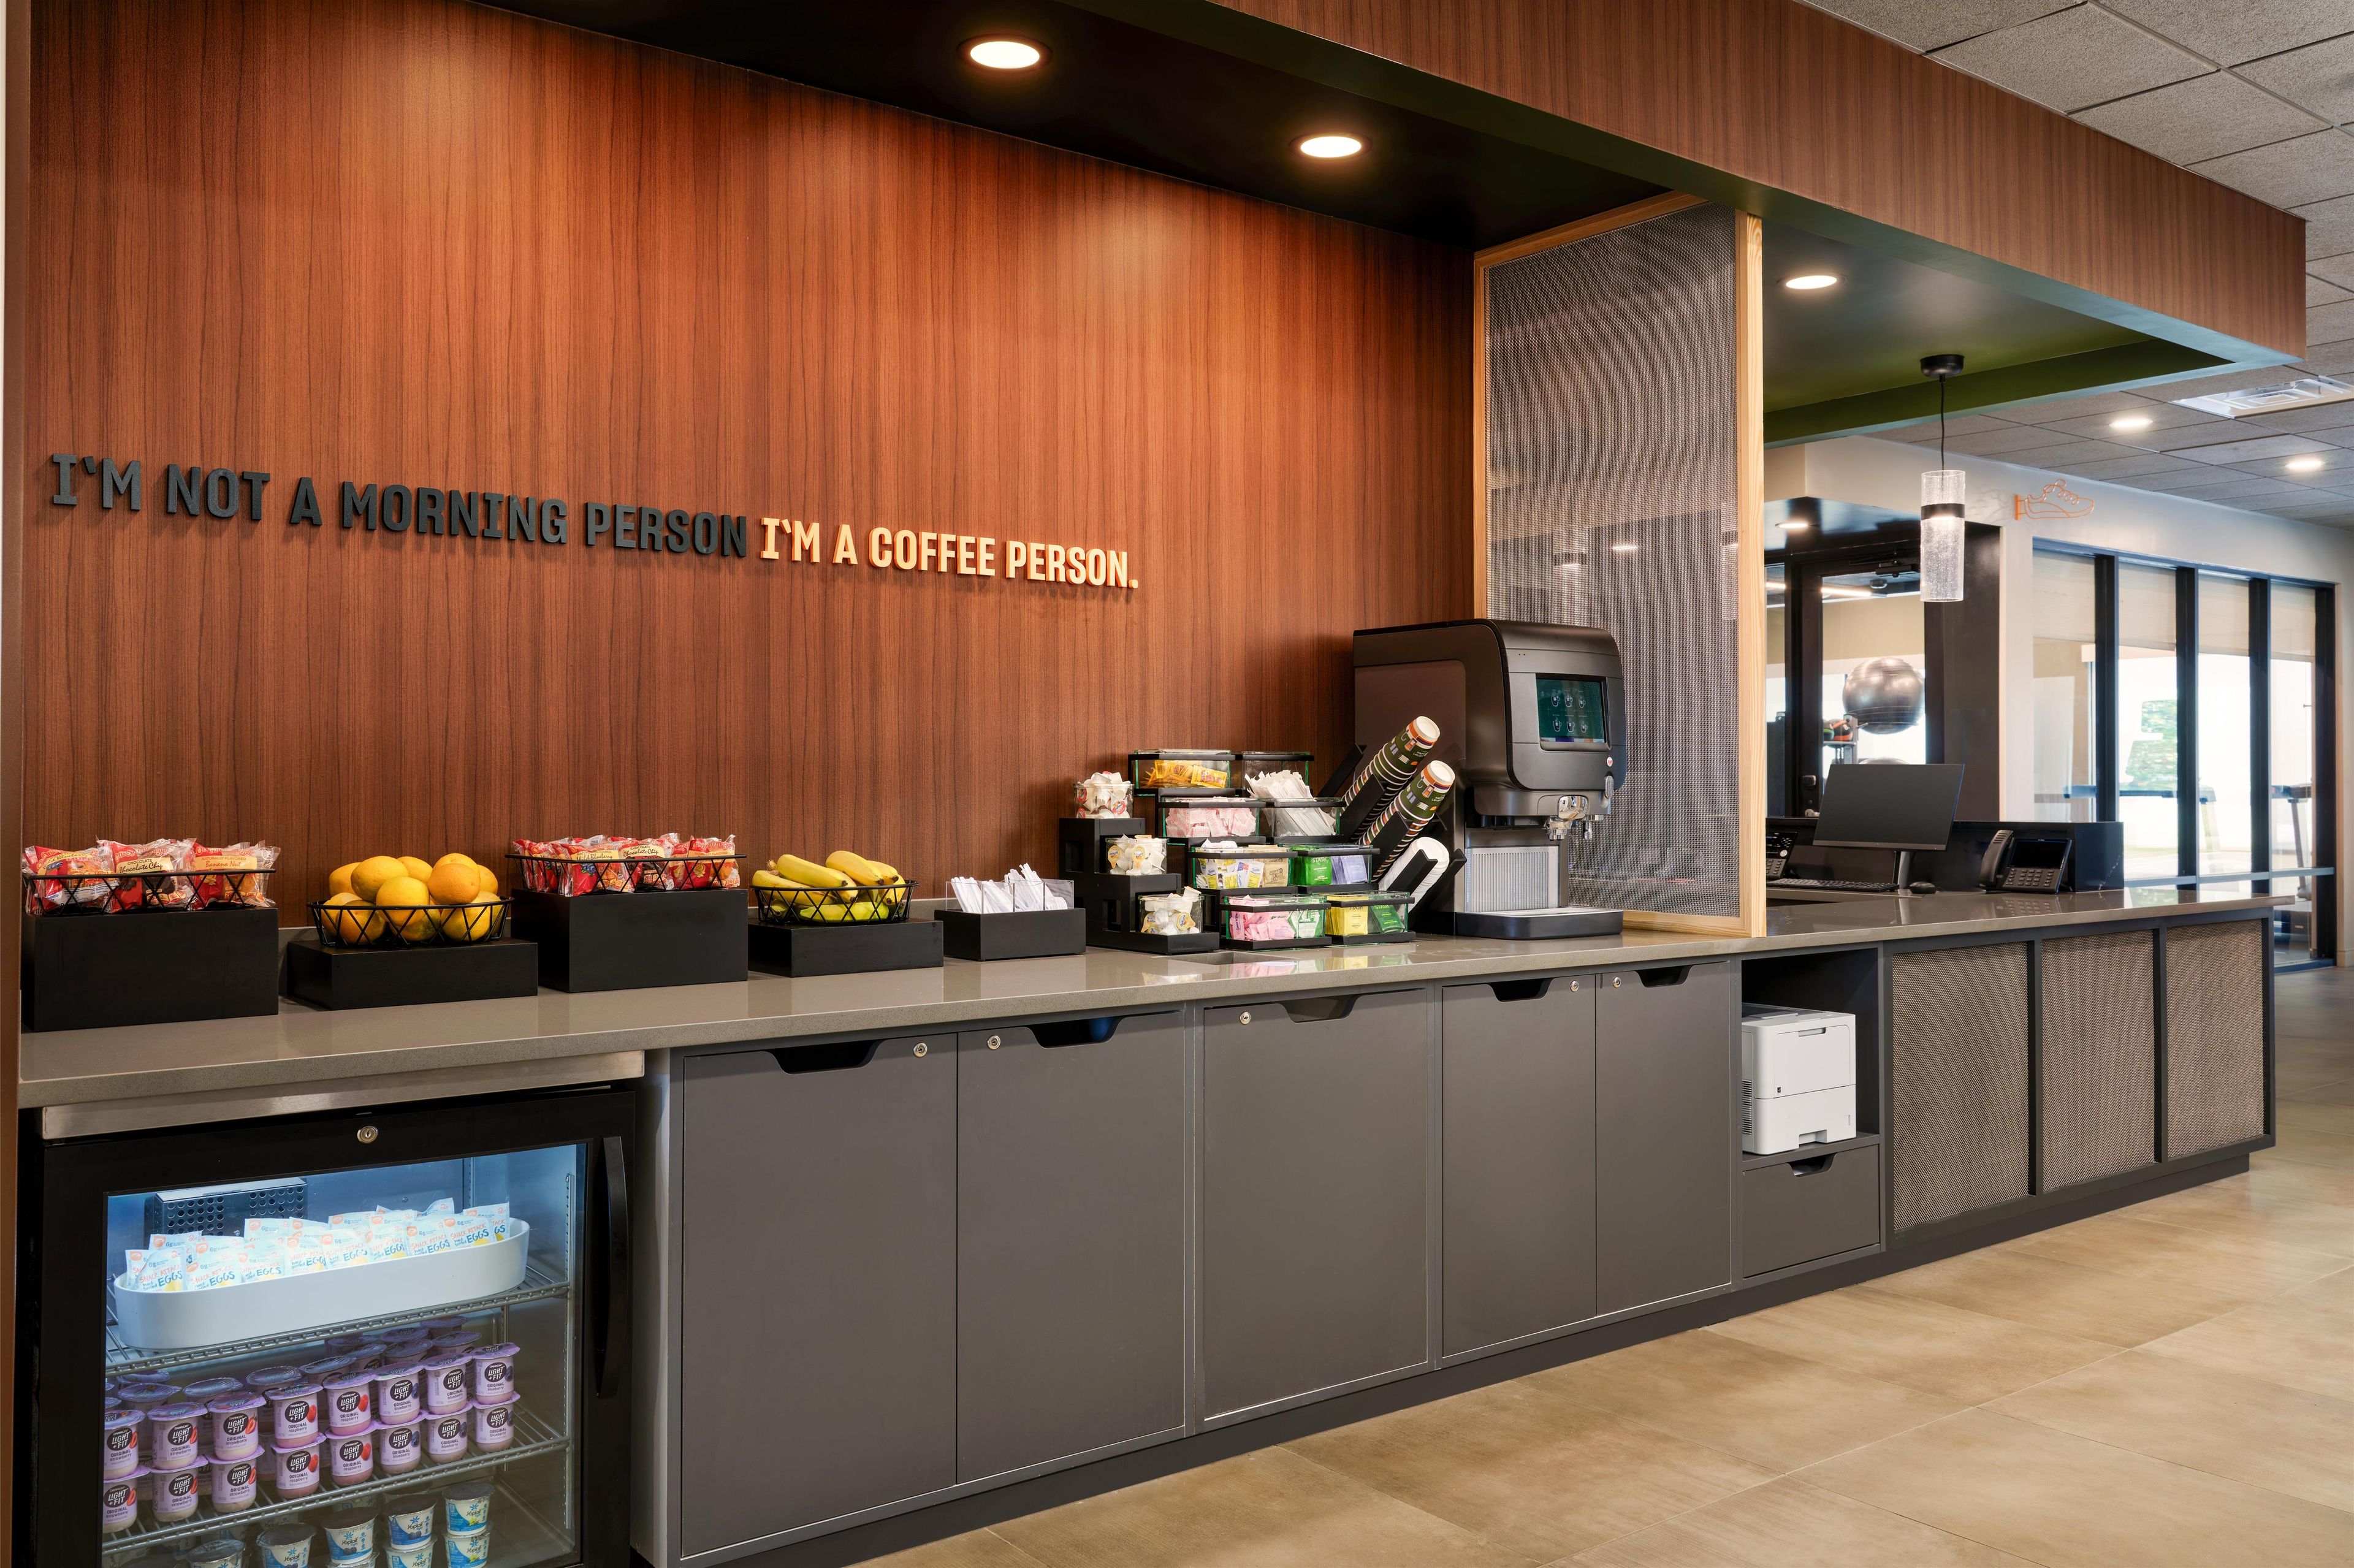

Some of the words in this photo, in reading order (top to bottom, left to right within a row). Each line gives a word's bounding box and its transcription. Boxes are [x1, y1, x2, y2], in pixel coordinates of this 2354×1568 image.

[51, 453, 142, 511] I'M
[167, 463, 270, 520] NOT
[289, 477, 322, 526] A
[342, 481, 569, 544] MORNING
[585, 501, 747, 558] PERSON
[760, 517, 820, 563] I'M
[832, 523, 858, 565] A
[869, 527, 996, 577] COFFEE
[1005, 540, 1138, 589] PERSON.
[623, 848, 648, 857] Chocolate
[467, 1228, 489, 1243] EGGS
[494, 1225, 506, 1234] GS
[384, 1243, 405, 1256] EGGS
[427, 1239, 451, 1253] EGGS
[158, 1271, 183, 1287] EGGS
[210, 1271, 235, 1287] EGGS
[488, 1366, 505, 1376] LIGHT
[447, 1372, 462, 1384] LIGHT
[394, 1383, 411, 1395] LIGHT
[340, 1395, 359, 1406] LIGHT
[289, 1404, 307, 1416] LIGHT
[490, 1410, 507, 1421] LIGHT
[227, 1417, 246, 1428] LIGHT
[442, 1421, 459, 1433] LIGHT
[112, 1431, 131, 1444] LIGHT
[172, 1426, 192, 1439] LIGHT
[393, 1431, 411, 1442] LIGHT
[110, 1449, 131, 1458] ORIGINAL
[343, 1444, 362, 1455] LIGHT
[110, 1453, 132, 1461] strawberry
[291, 1455, 309, 1466] LIGHT
[232, 1467, 250, 1479] LIGHT
[173, 1477, 192, 1490] LIGHT
[108, 1488, 128, 1501] LIGHT
